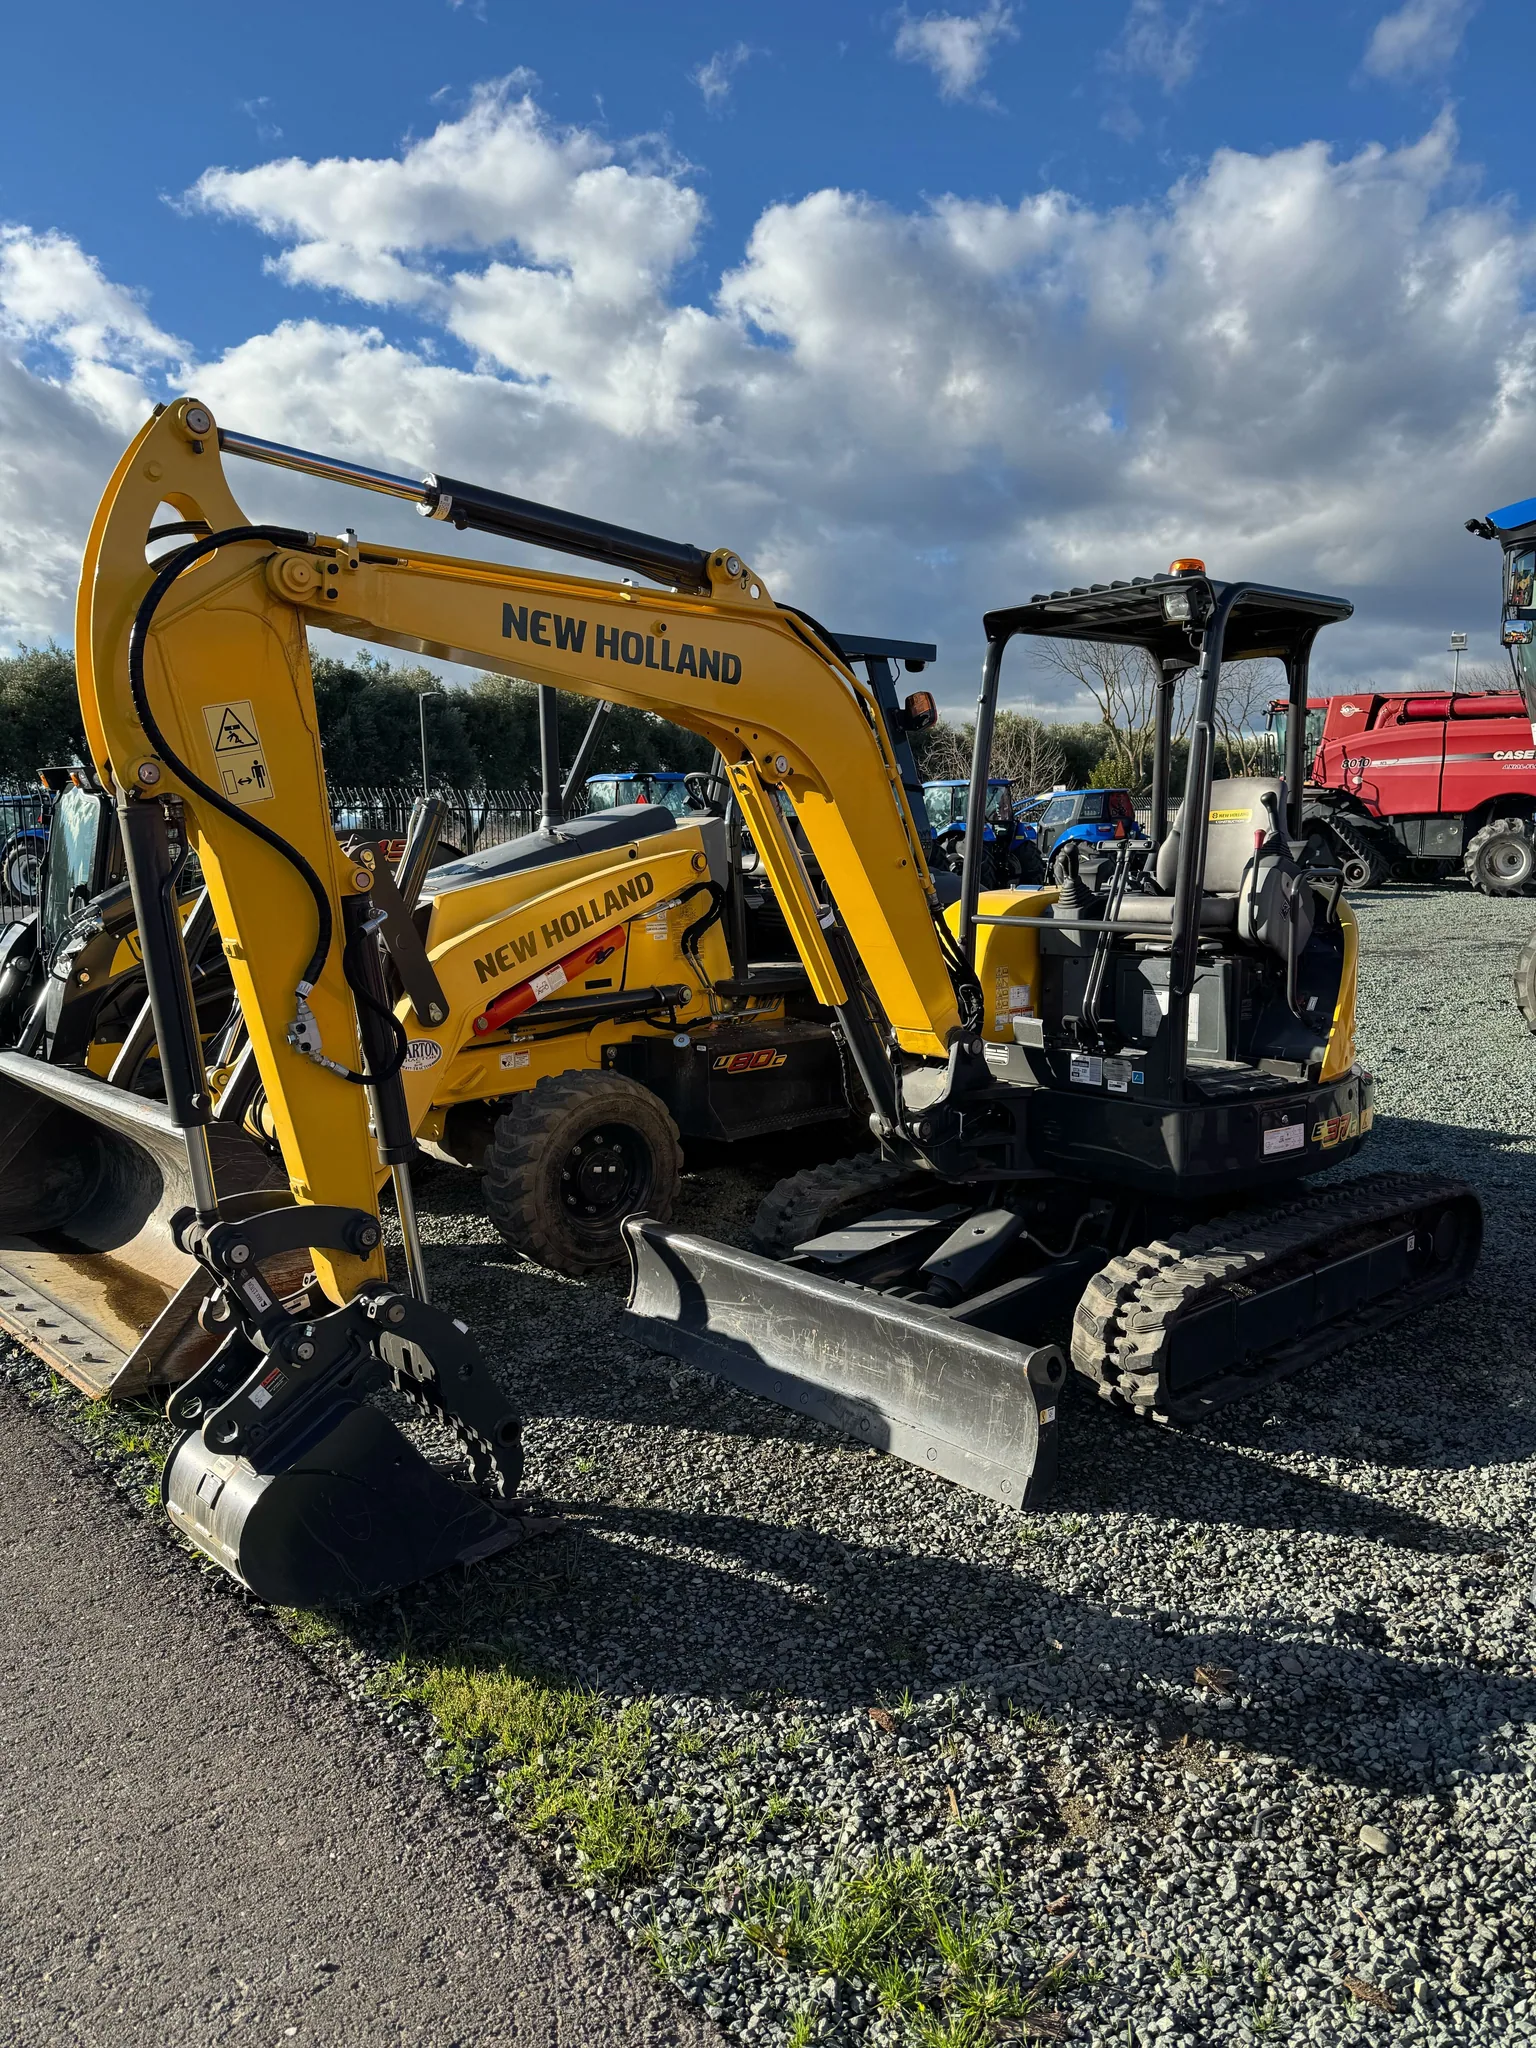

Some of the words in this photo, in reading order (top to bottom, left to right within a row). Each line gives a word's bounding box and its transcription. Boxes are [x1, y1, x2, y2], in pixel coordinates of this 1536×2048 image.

[502, 602, 587, 653] NEW
[595, 624, 742, 685] HOLLAND
[1493, 750, 1535, 760] CASE
[473, 931, 538, 984] NEW
[540, 871, 654, 949] HOLLAND
